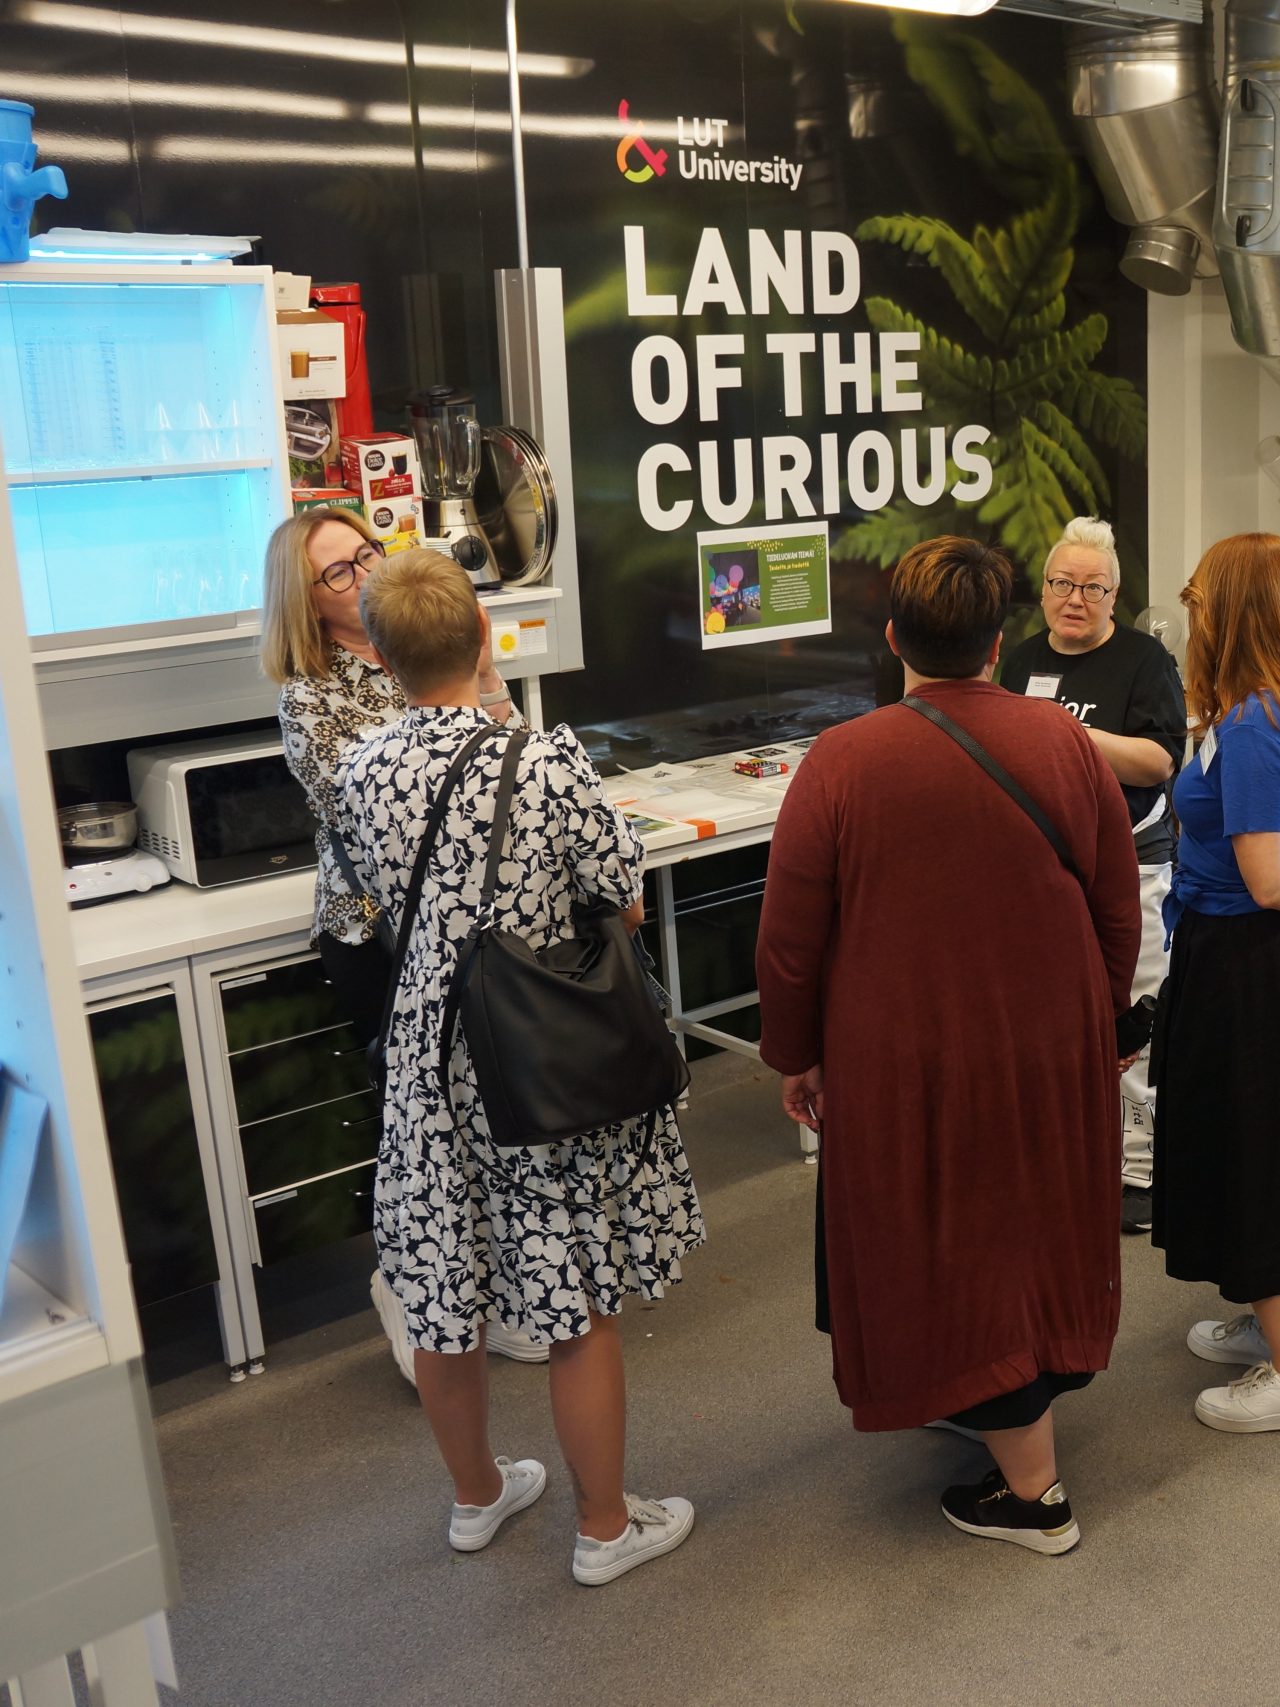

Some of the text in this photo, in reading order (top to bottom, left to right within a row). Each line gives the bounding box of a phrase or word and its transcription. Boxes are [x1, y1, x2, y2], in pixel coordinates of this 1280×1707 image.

[677, 116, 728, 148] LUT
[678, 150, 803, 191] University
[623, 225, 861, 317] LAND
[630, 331, 923, 426] OF THE
[330, 497, 360, 506] CLIPPER
[636, 424, 992, 532] CURIOUS
